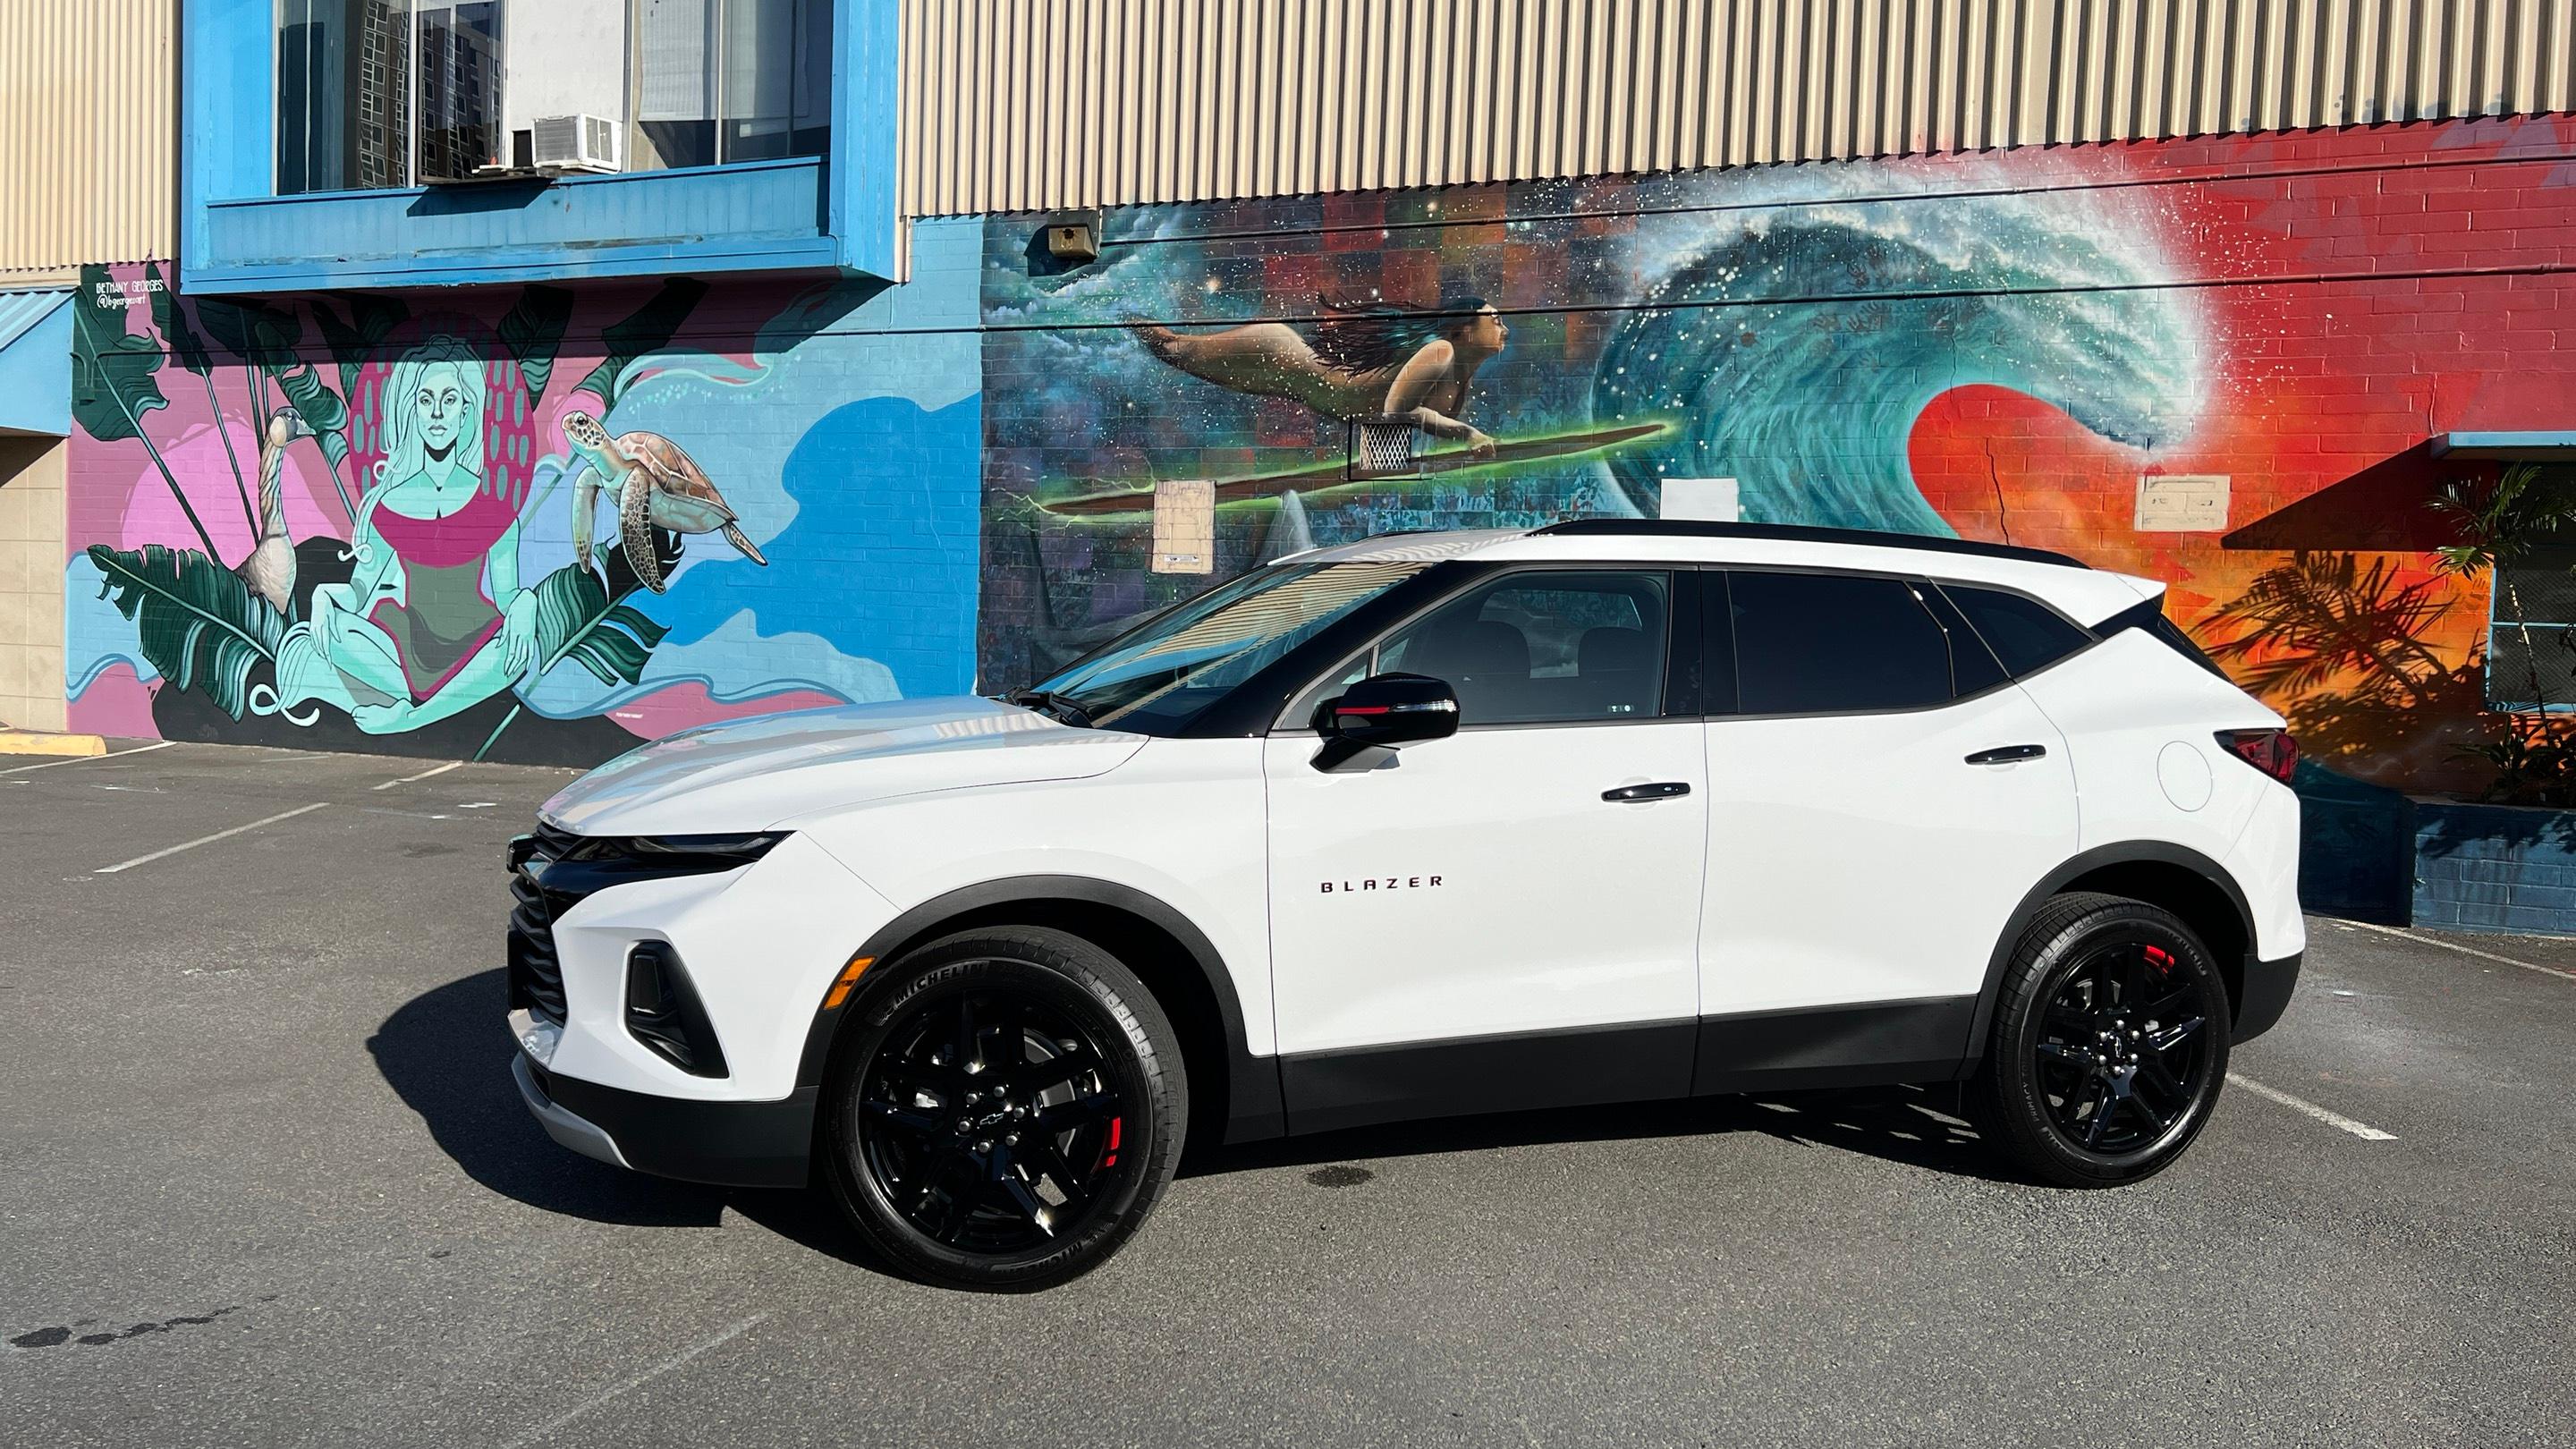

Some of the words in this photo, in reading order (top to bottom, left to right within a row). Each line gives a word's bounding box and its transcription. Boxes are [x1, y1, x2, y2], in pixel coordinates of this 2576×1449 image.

[96, 282, 128, 294] BETHANY
[131, 279, 164, 292] GEORGES
[1320, 876, 1442, 893] BLAZER
[894, 963, 983, 1003] MICHELIN
